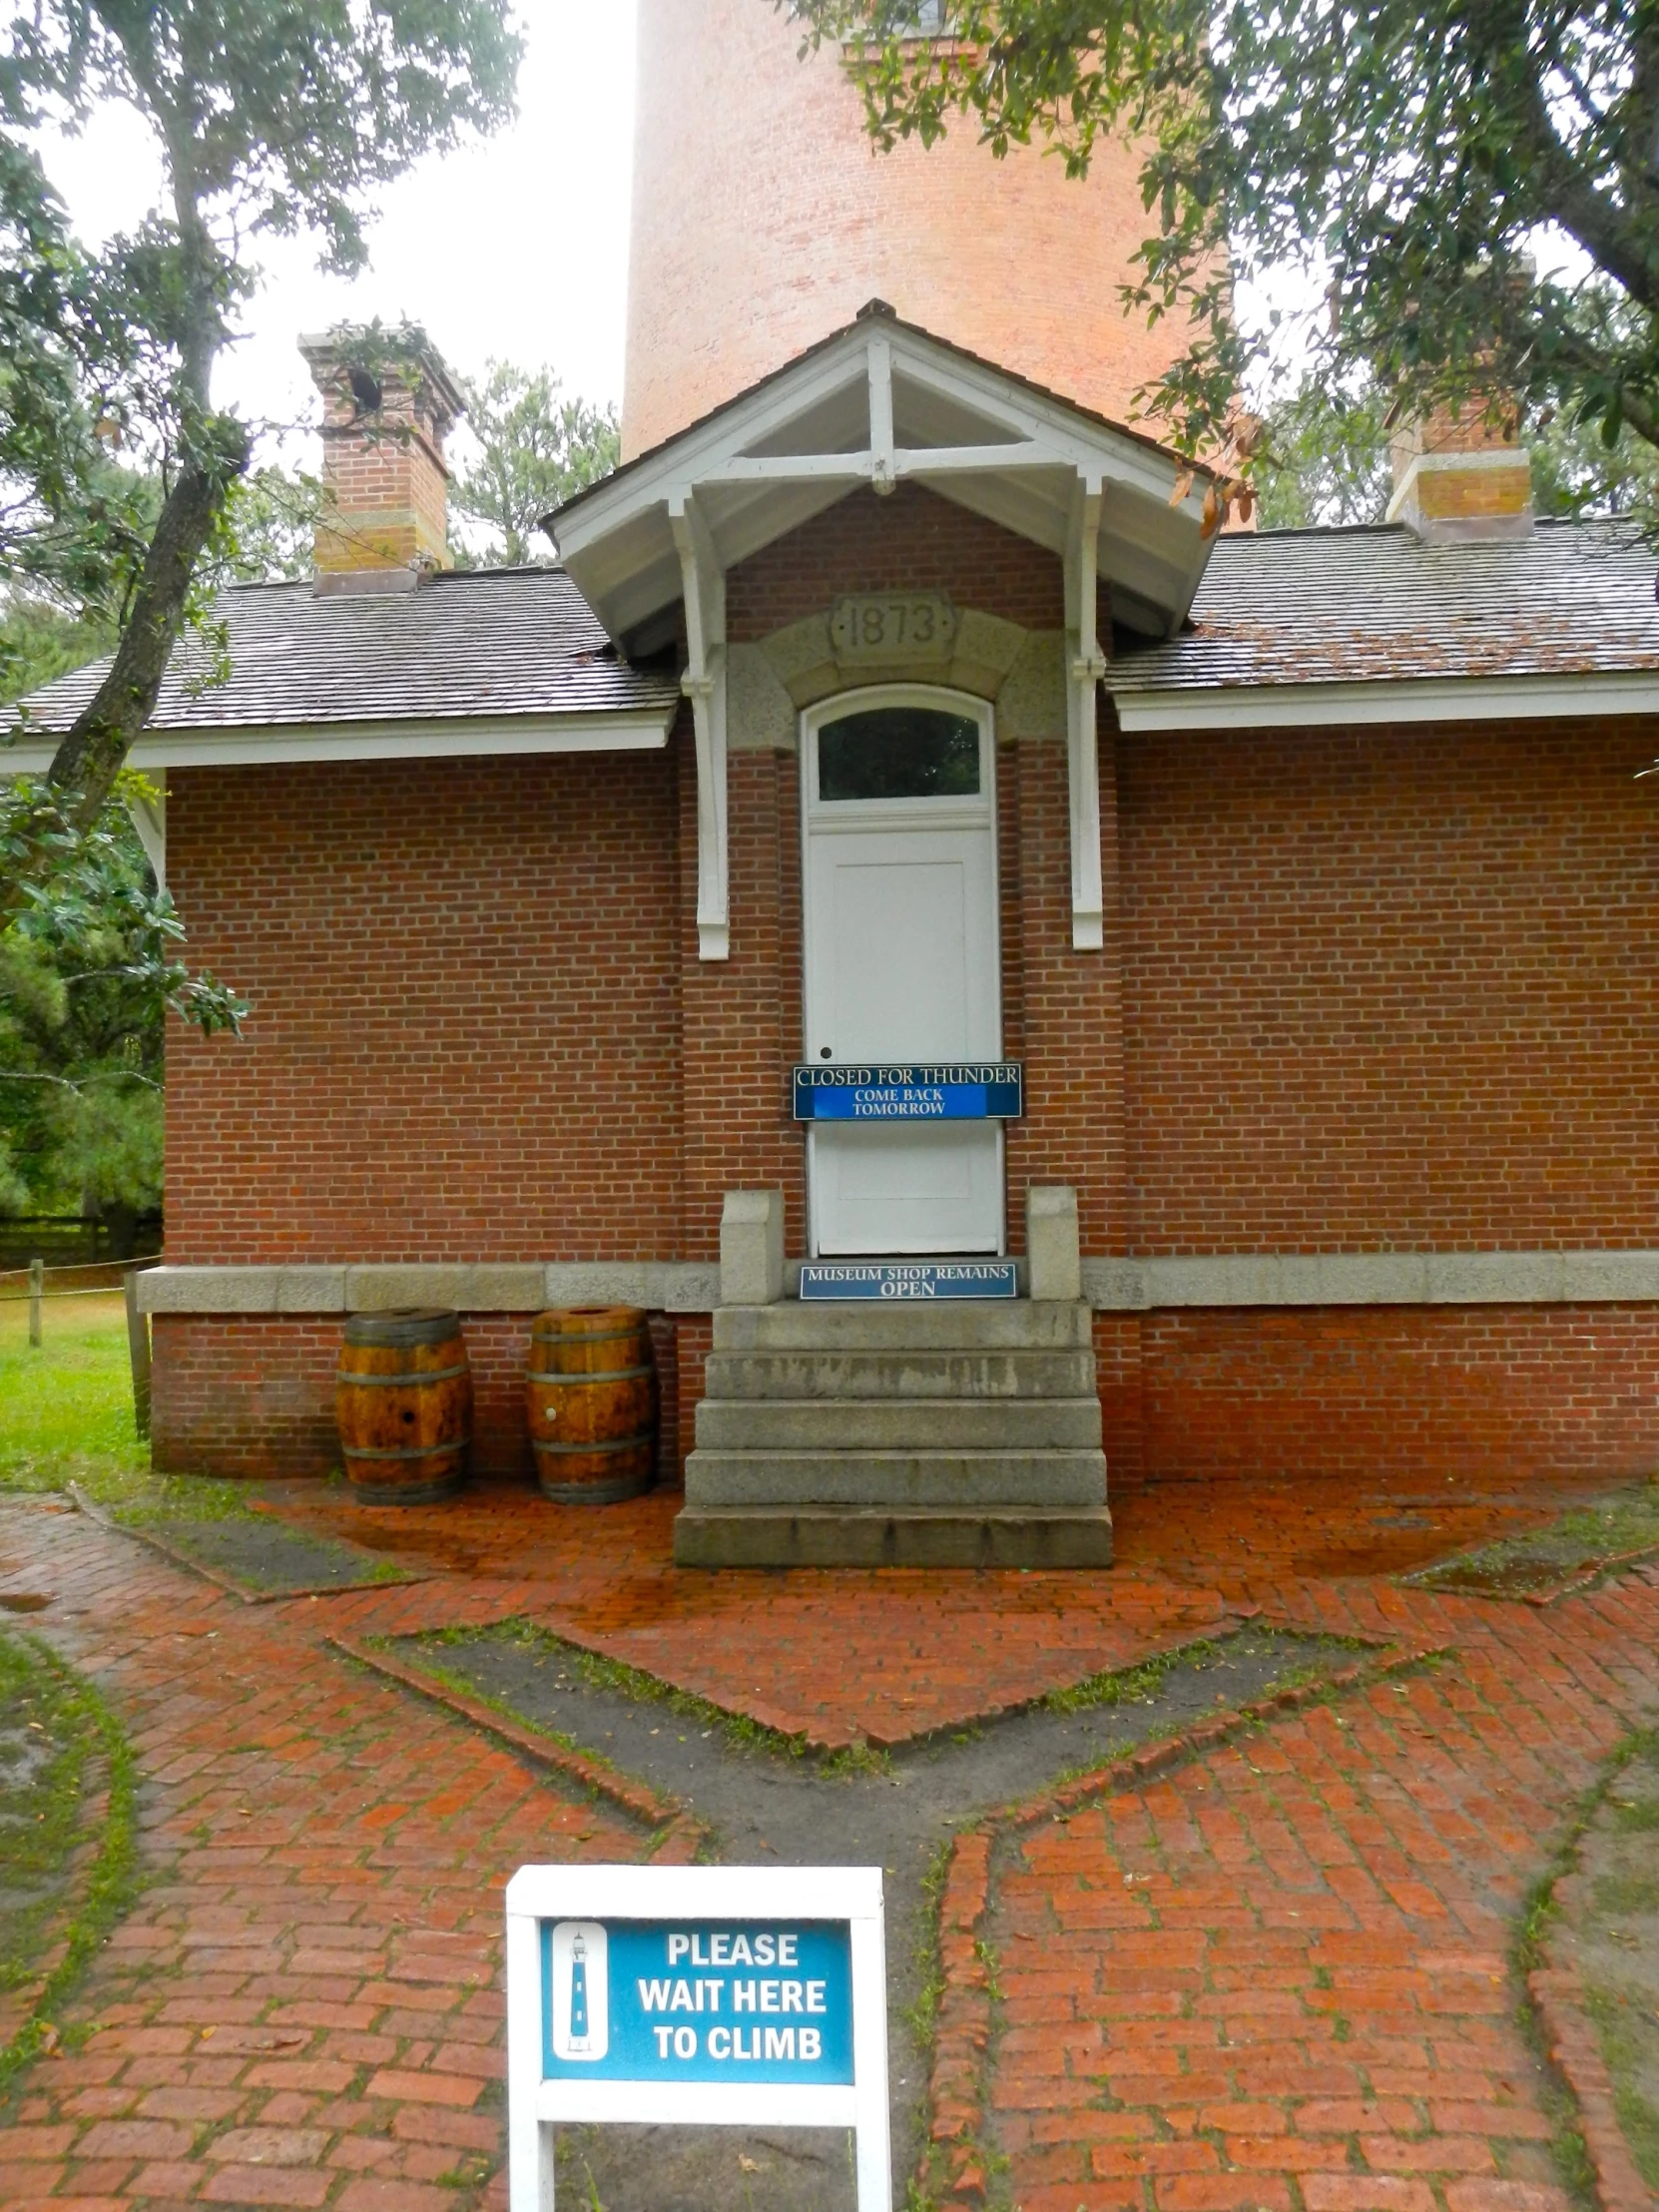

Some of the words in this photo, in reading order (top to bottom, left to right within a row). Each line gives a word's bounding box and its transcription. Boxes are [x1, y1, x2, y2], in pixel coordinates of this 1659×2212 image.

[850, 604, 935, 646] 1873
[797, 1069, 871, 1086] CLOSED
[877, 1068, 914, 1085] FOR
[919, 1067, 1018, 1084] THUNDER
[854, 1089, 899, 1102] COME
[903, 1088, 943, 1101] BACK
[852, 1102, 946, 1115] TOMORROW
[809, 1268, 882, 1281] MUSEUM
[887, 1267, 931, 1280] SHOP
[936, 1266, 1009, 1279] REMAINS
[880, 1281, 936, 1297] OPEN
[668, 1934, 799, 1966] PLEASE
[638, 1978, 724, 2012] WAIT
[733, 1979, 827, 2012] HERE
[654, 2026, 697, 2058] TO
[708, 2026, 822, 2060] CLIMB
